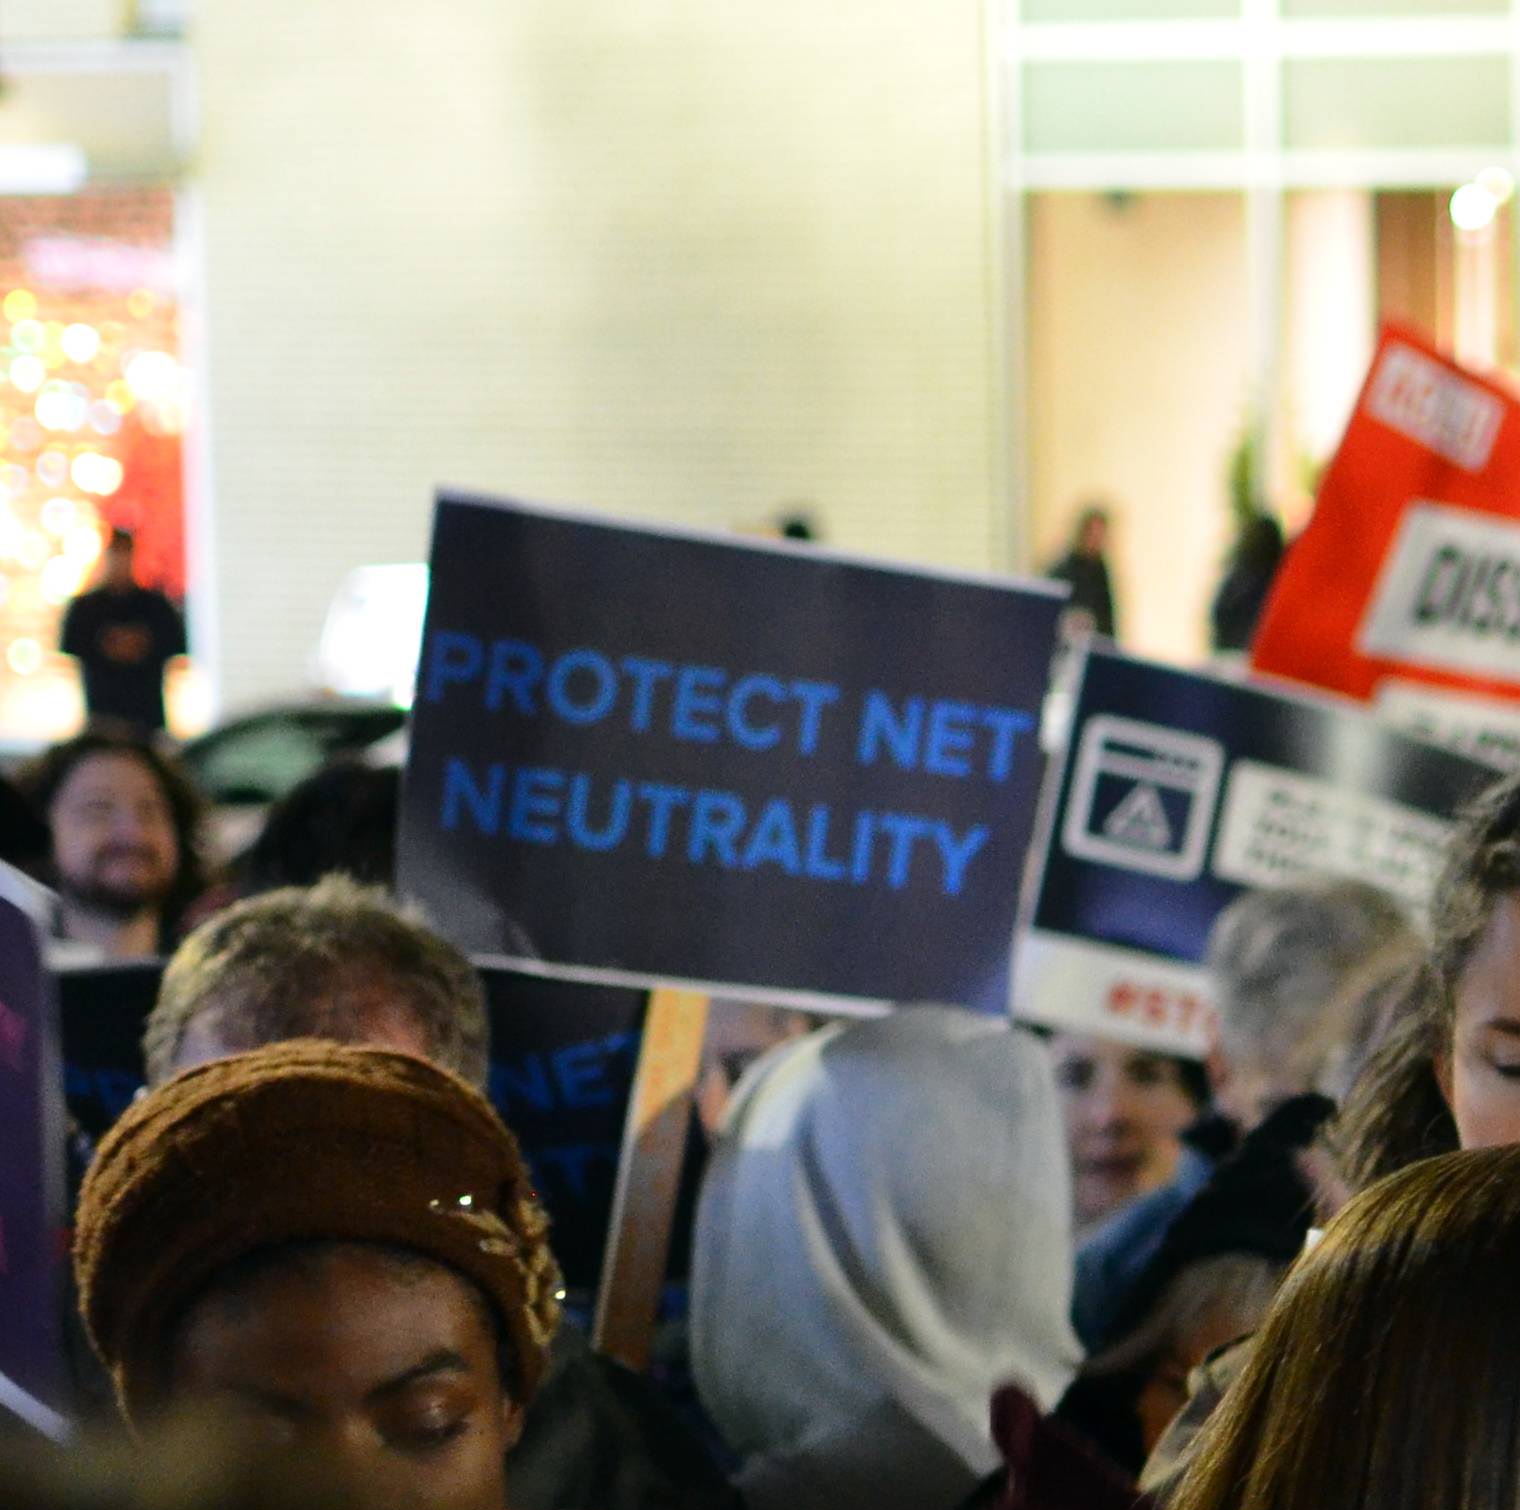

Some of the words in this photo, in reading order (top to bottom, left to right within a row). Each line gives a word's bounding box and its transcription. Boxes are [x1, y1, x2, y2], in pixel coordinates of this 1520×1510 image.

[424, 630, 841, 757] PROTECT
[856, 687, 1035, 783] NET
[440, 756, 991, 895] NEUTRALITY
